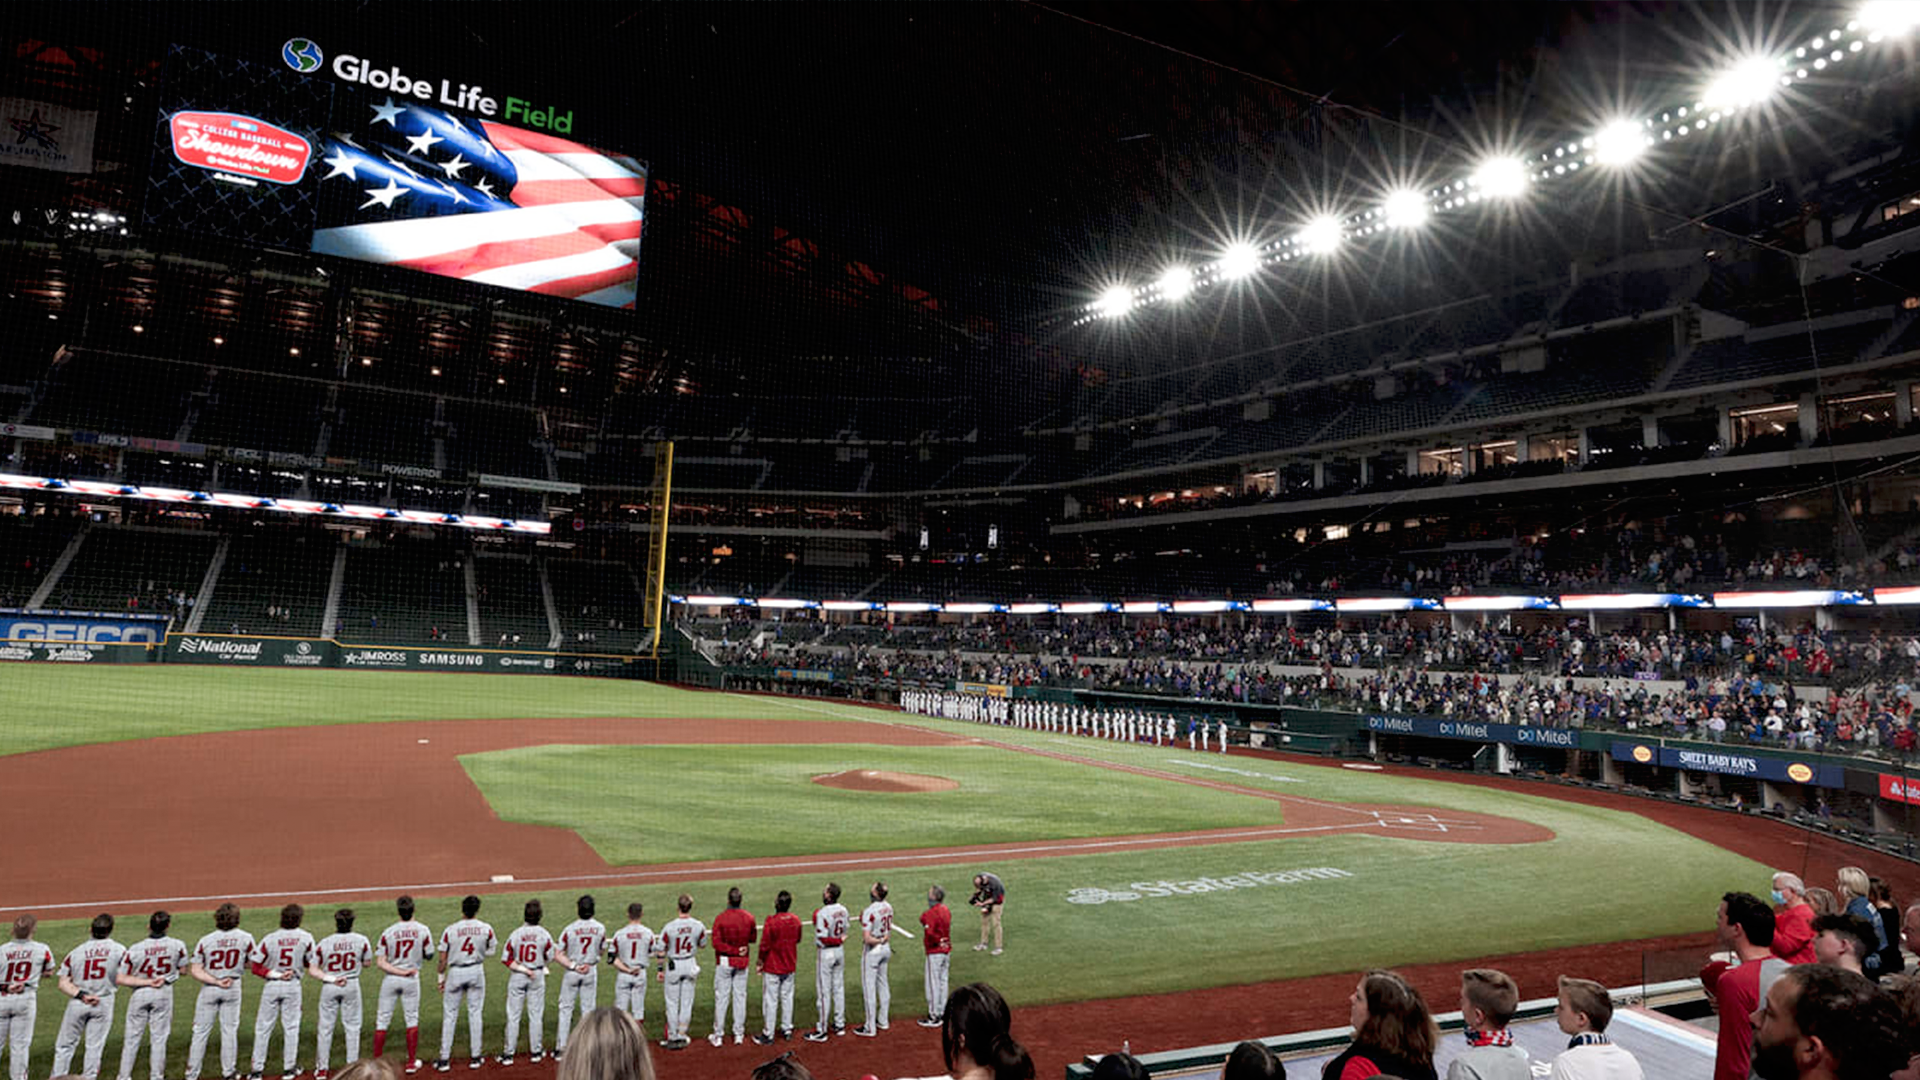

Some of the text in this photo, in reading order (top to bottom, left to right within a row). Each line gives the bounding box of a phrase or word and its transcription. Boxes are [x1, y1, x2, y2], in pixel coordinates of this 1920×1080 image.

[332, 54, 573, 134] Globe Life Field
[202, 124, 281, 148] COLLEGE BASEBALL
[178, 129, 299, 169] Showdown
[382, 464, 442, 479] POWERADE
[8, 622, 157, 650] GEICO
[197, 639, 261, 655] National
[419, 653, 484, 666] SAMSUNG
[1384, 717, 1413, 732] Mitel
[1455, 722, 1489, 738] Mitel
[1536, 728, 1573, 745] Mitel
[1707, 754, 1730, 769] BABY
[833, 919, 843, 936] 6
[394, 939, 414, 959] 17
[461, 937, 474, 956] 4
[519, 944, 537, 963] 16
[580, 936, 592, 955] 7
[632, 941, 637, 959] 1
[675, 936, 693, 954] 14
[139, 956, 171, 978] 45
[209, 949, 240, 970] 20
[279, 948, 293, 967] 5
[328, 952, 356, 972] 26
[5, 961, 32, 982] 19
[83, 958, 107, 980] 15
